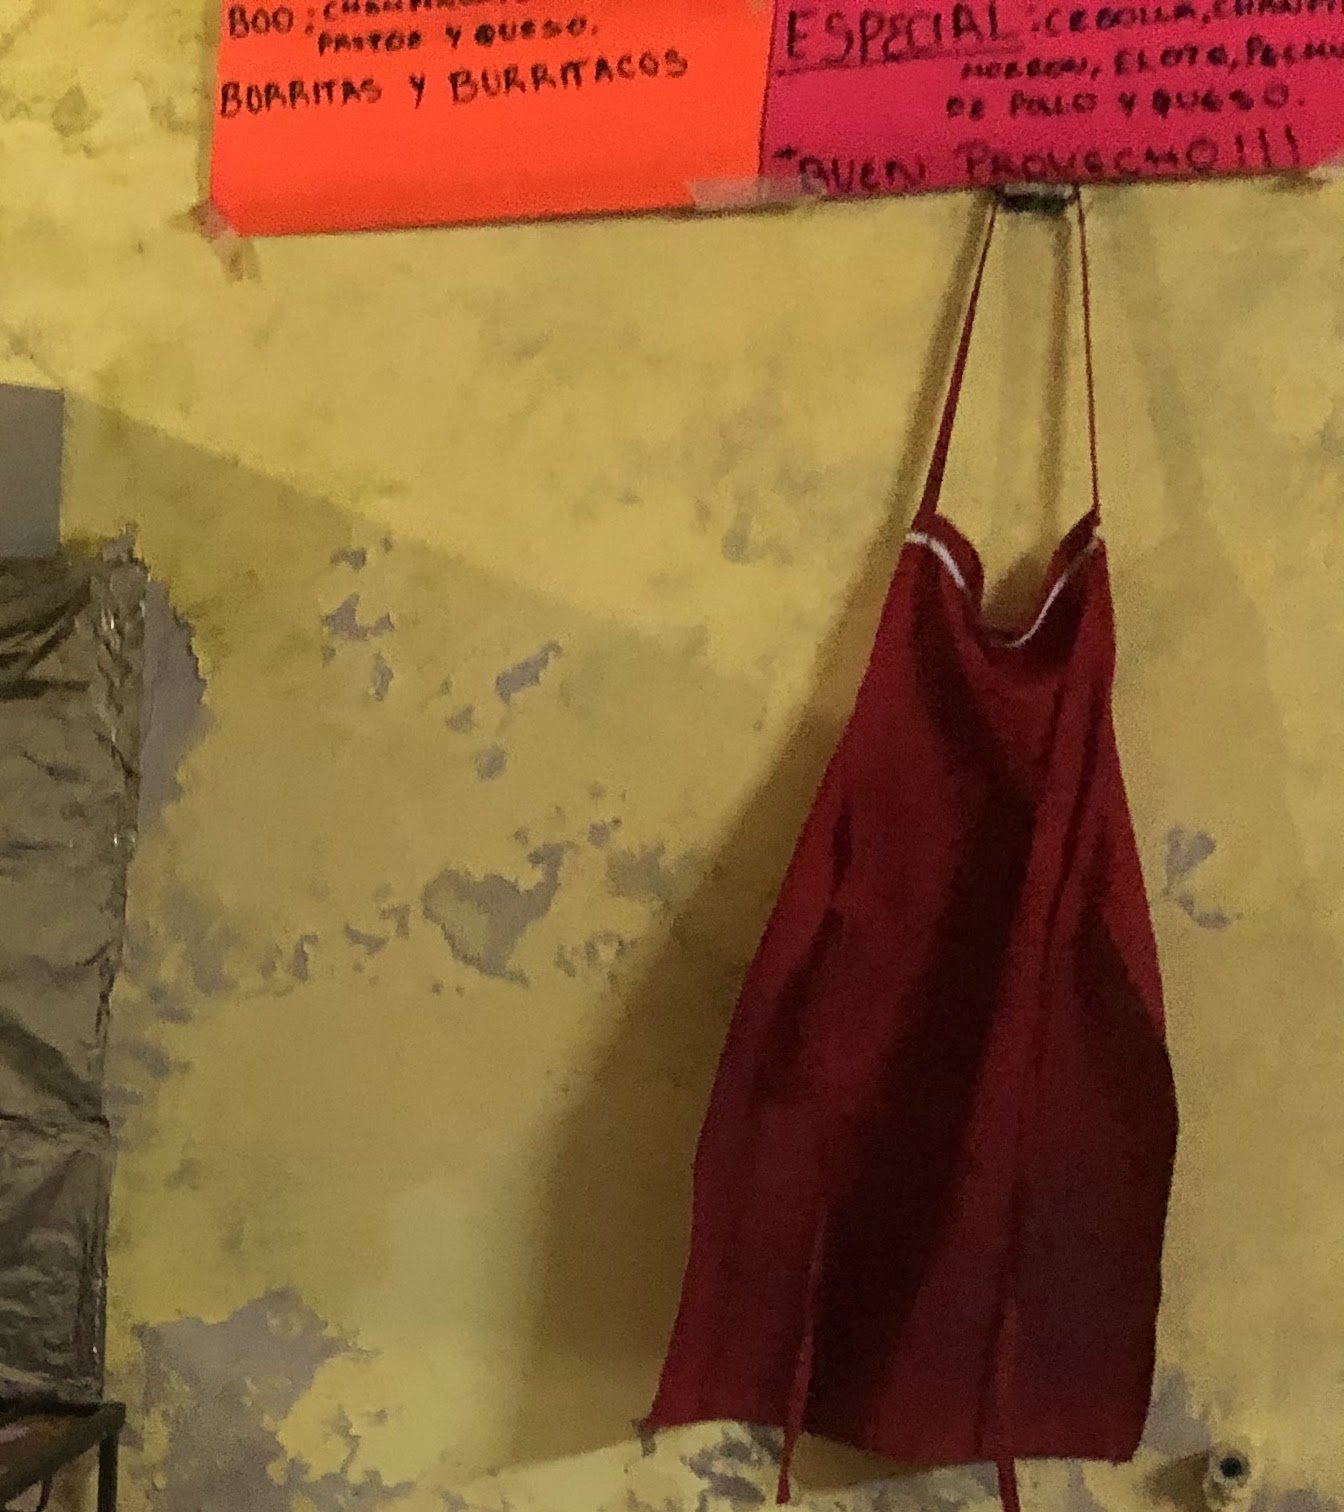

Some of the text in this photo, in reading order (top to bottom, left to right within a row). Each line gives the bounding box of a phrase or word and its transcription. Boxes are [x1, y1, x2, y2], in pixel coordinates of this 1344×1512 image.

[444, 23, 462, 49] Y
[219, 48, 689, 118] BORRITAS Y BURRITACOS
[1118, 91, 1137, 117] Y
